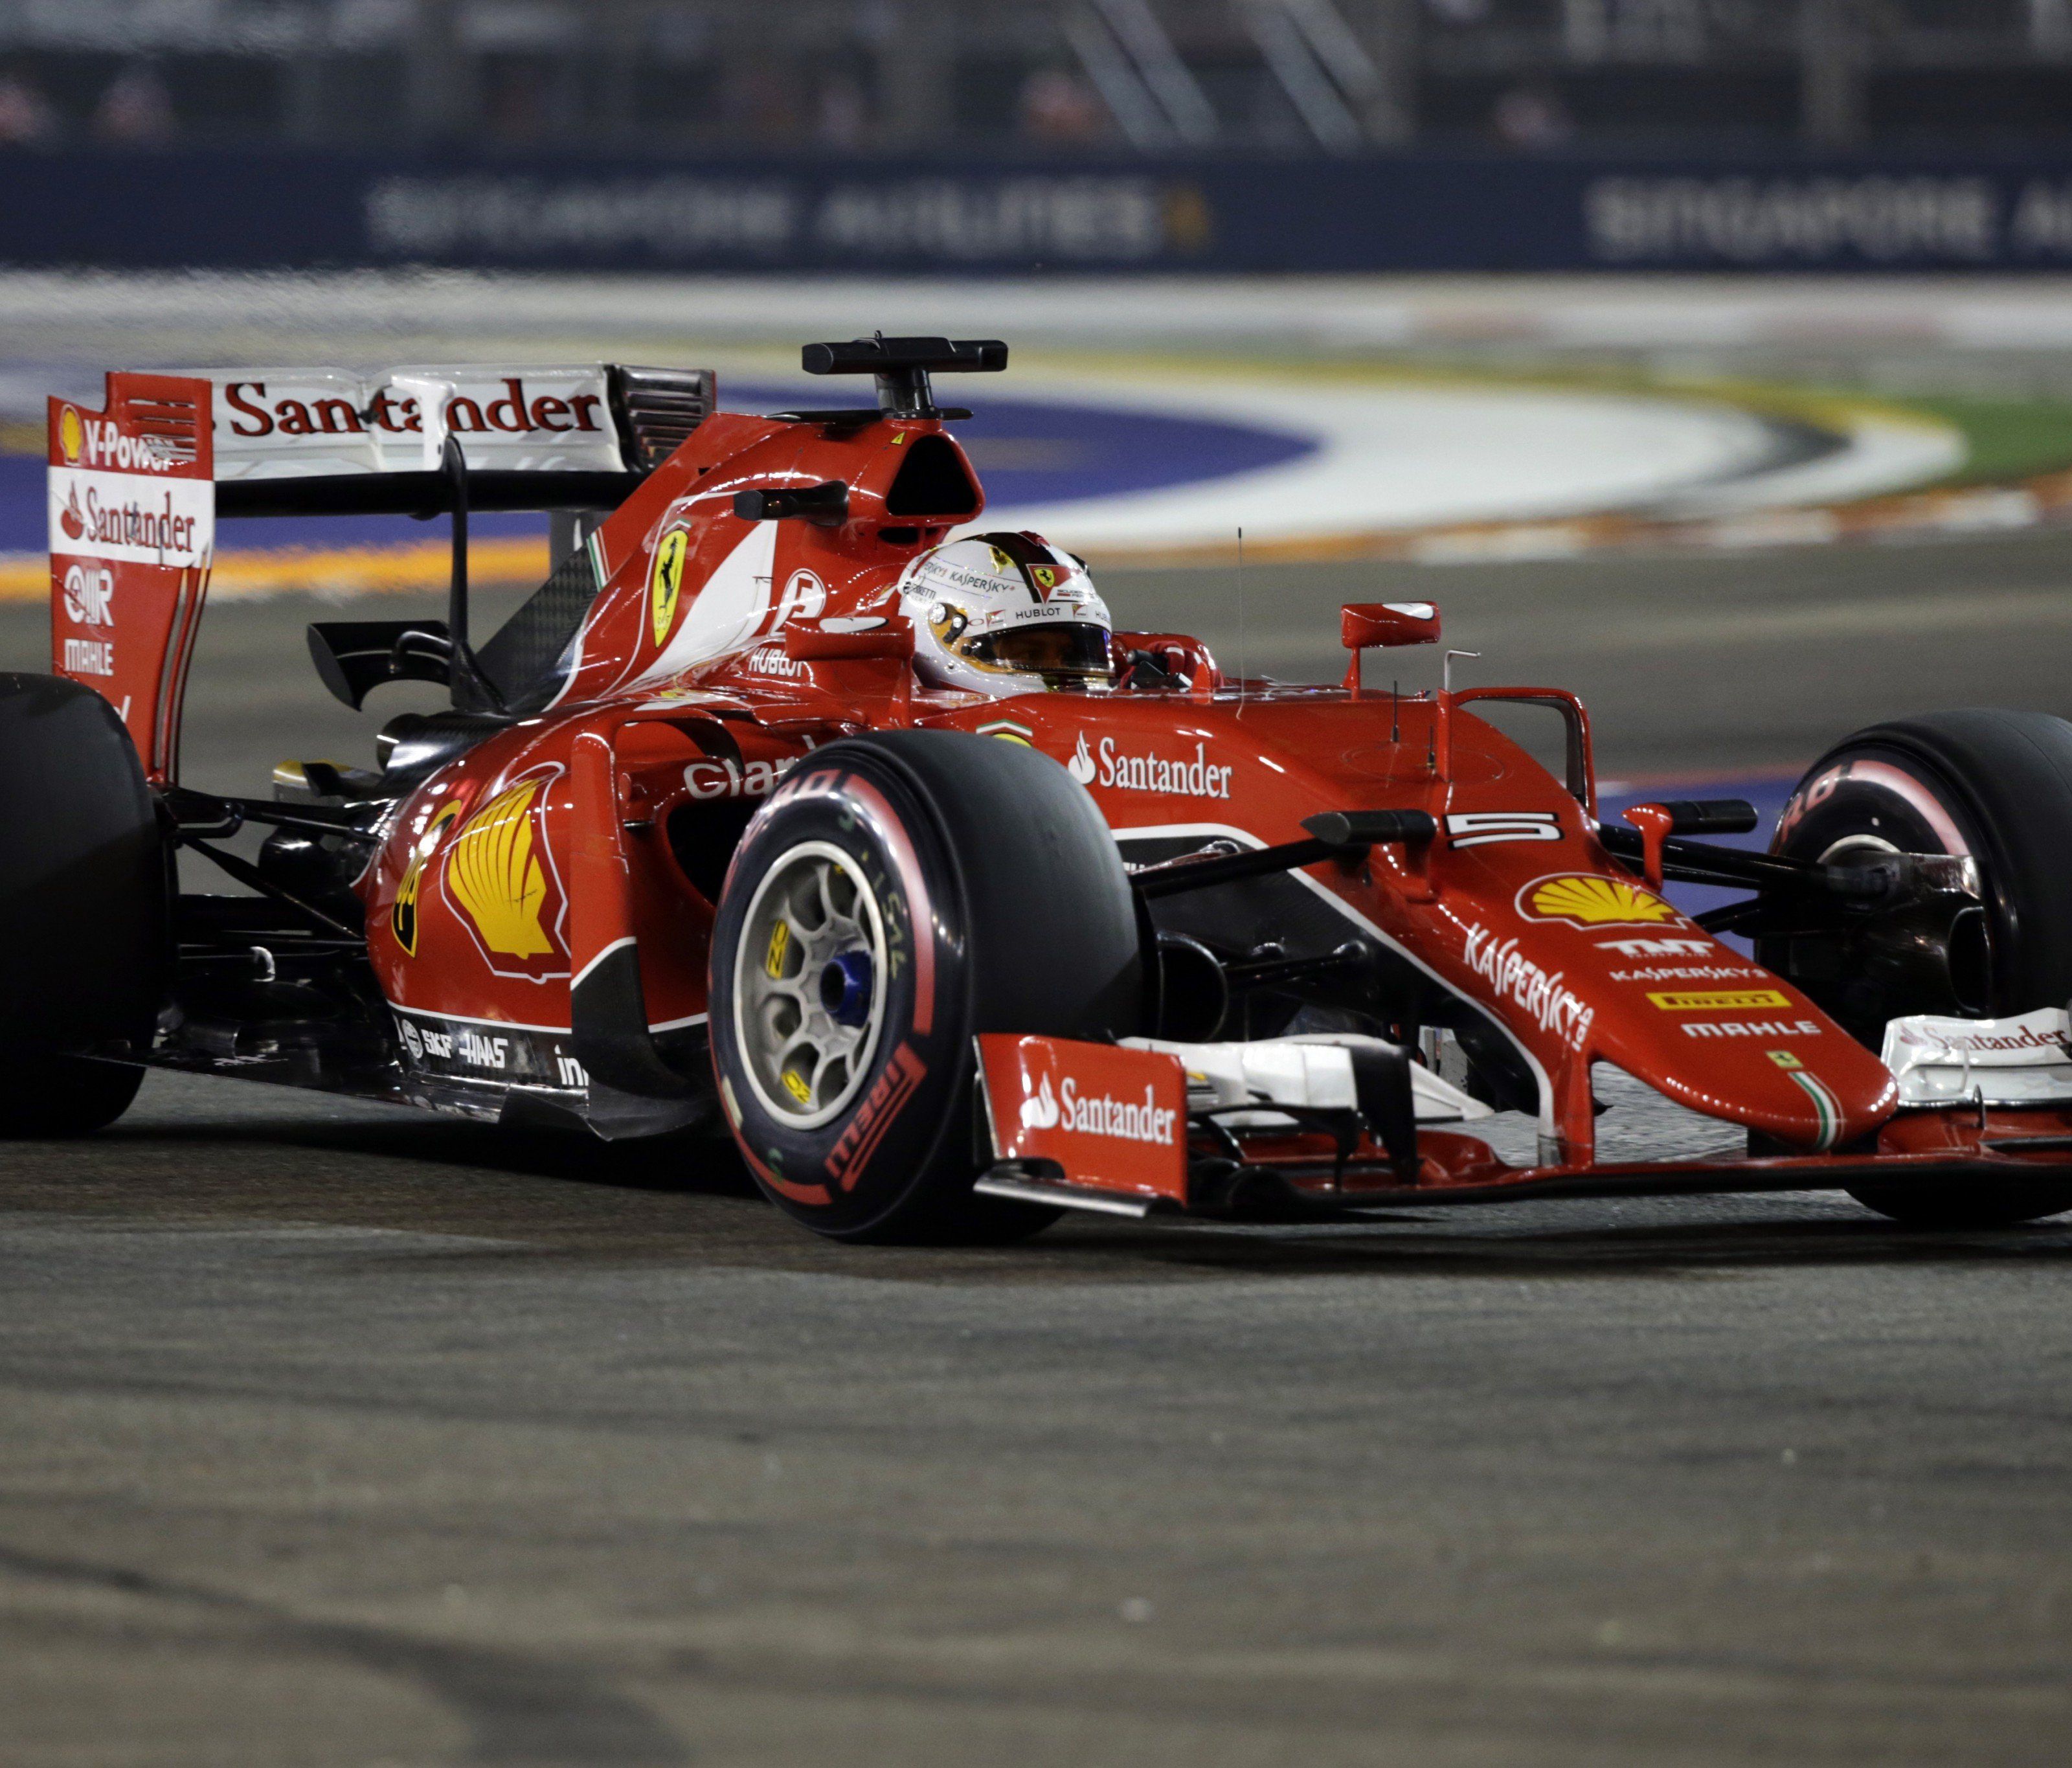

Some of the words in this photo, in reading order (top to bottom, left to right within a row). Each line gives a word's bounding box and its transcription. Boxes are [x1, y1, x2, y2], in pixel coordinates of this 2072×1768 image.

[225, 378, 602, 437] Santander
[87, 486, 195, 552] Santander
[949, 571, 1010, 593] KASPERSKY
[1016, 607, 1061, 620] HUBLOT
[1099, 737, 1232, 799] Santander
[1445, 813, 1563, 850] 5
[1593, 938, 1715, 955] TNT
[1464, 922, 1585, 1041] KASPERSKY
[1609, 966, 1750, 980] KASPERSKY
[1662, 993, 1774, 1005] PIRELLI
[421, 1028, 452, 1058] SKF
[1681, 1021, 1822, 1037] MAHLE
[458, 1033, 509, 1069] HAAS
[825, 1039, 928, 1192] PIRELLI
[1061, 1076, 1177, 1145] Santander
